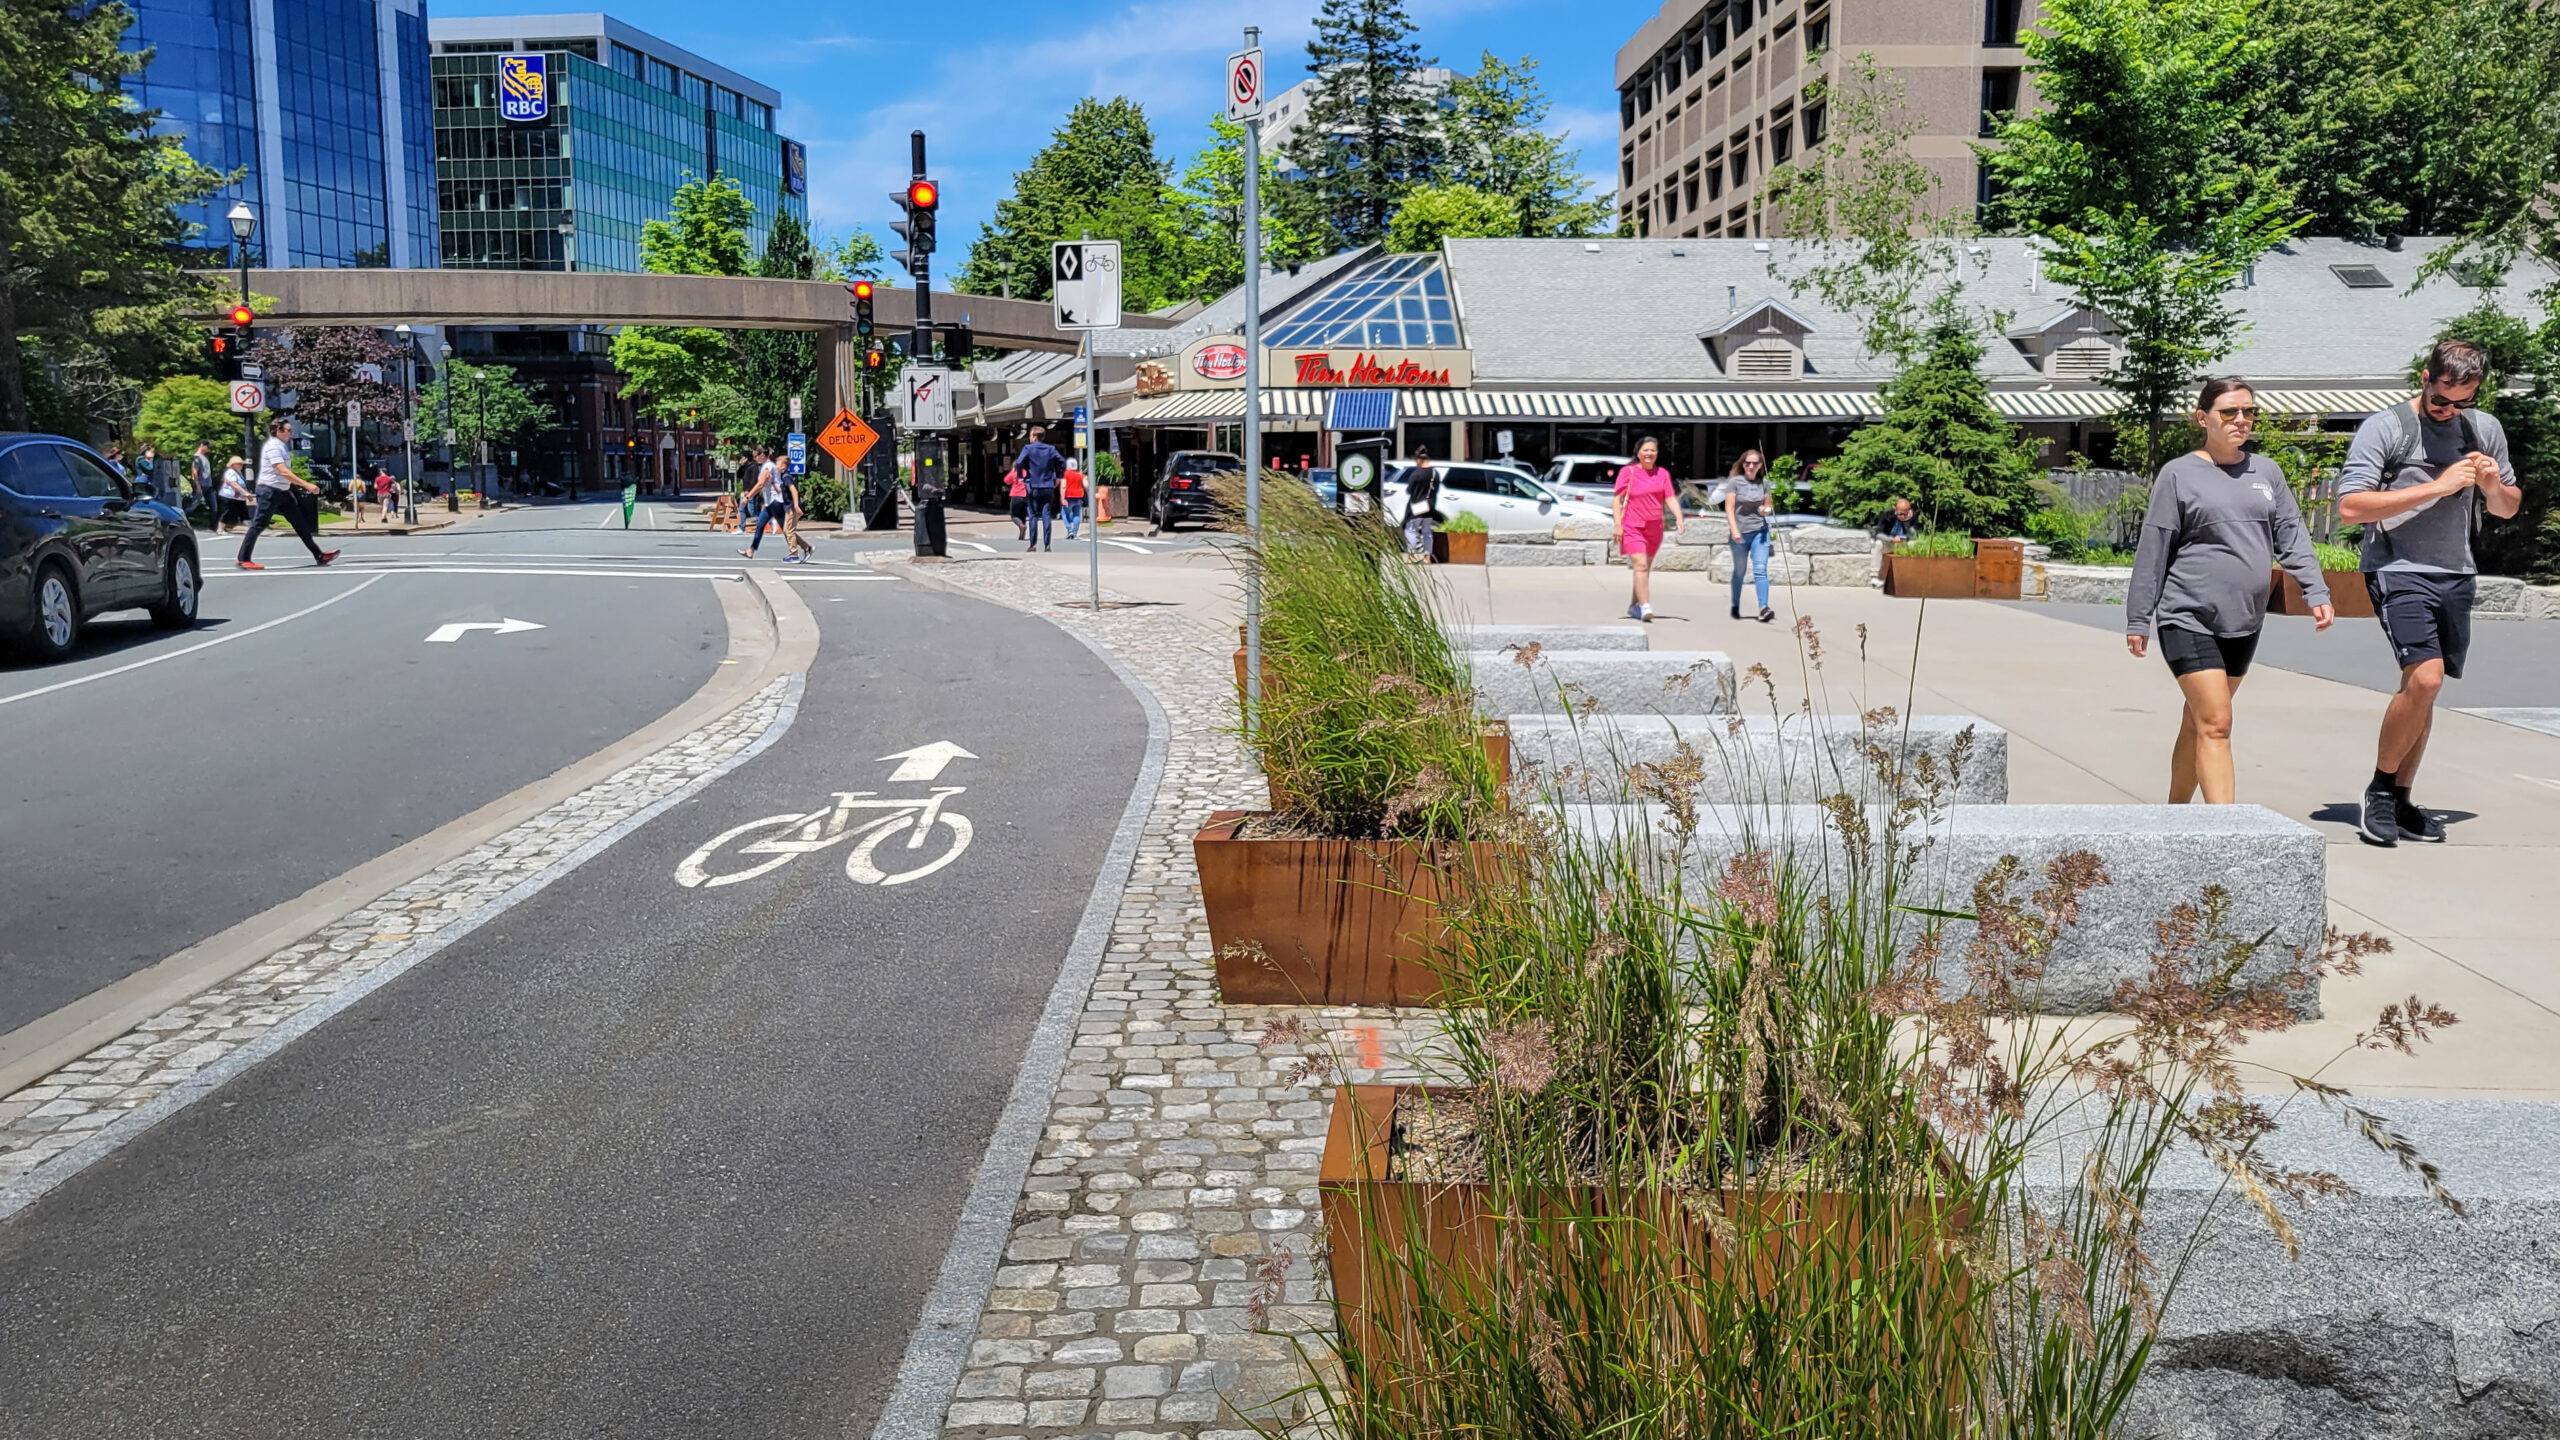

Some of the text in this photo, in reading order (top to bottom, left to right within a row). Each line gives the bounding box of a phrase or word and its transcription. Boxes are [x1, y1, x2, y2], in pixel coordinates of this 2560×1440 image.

[506, 101, 543, 115] RBC
[1194, 351, 1247, 369] Tim Horton
[1295, 352, 1449, 385] Tim Hortons
[829, 435, 867, 446] DETOUR
[790, 450, 804, 459] 102
[1352, 465, 1363, 479] P
